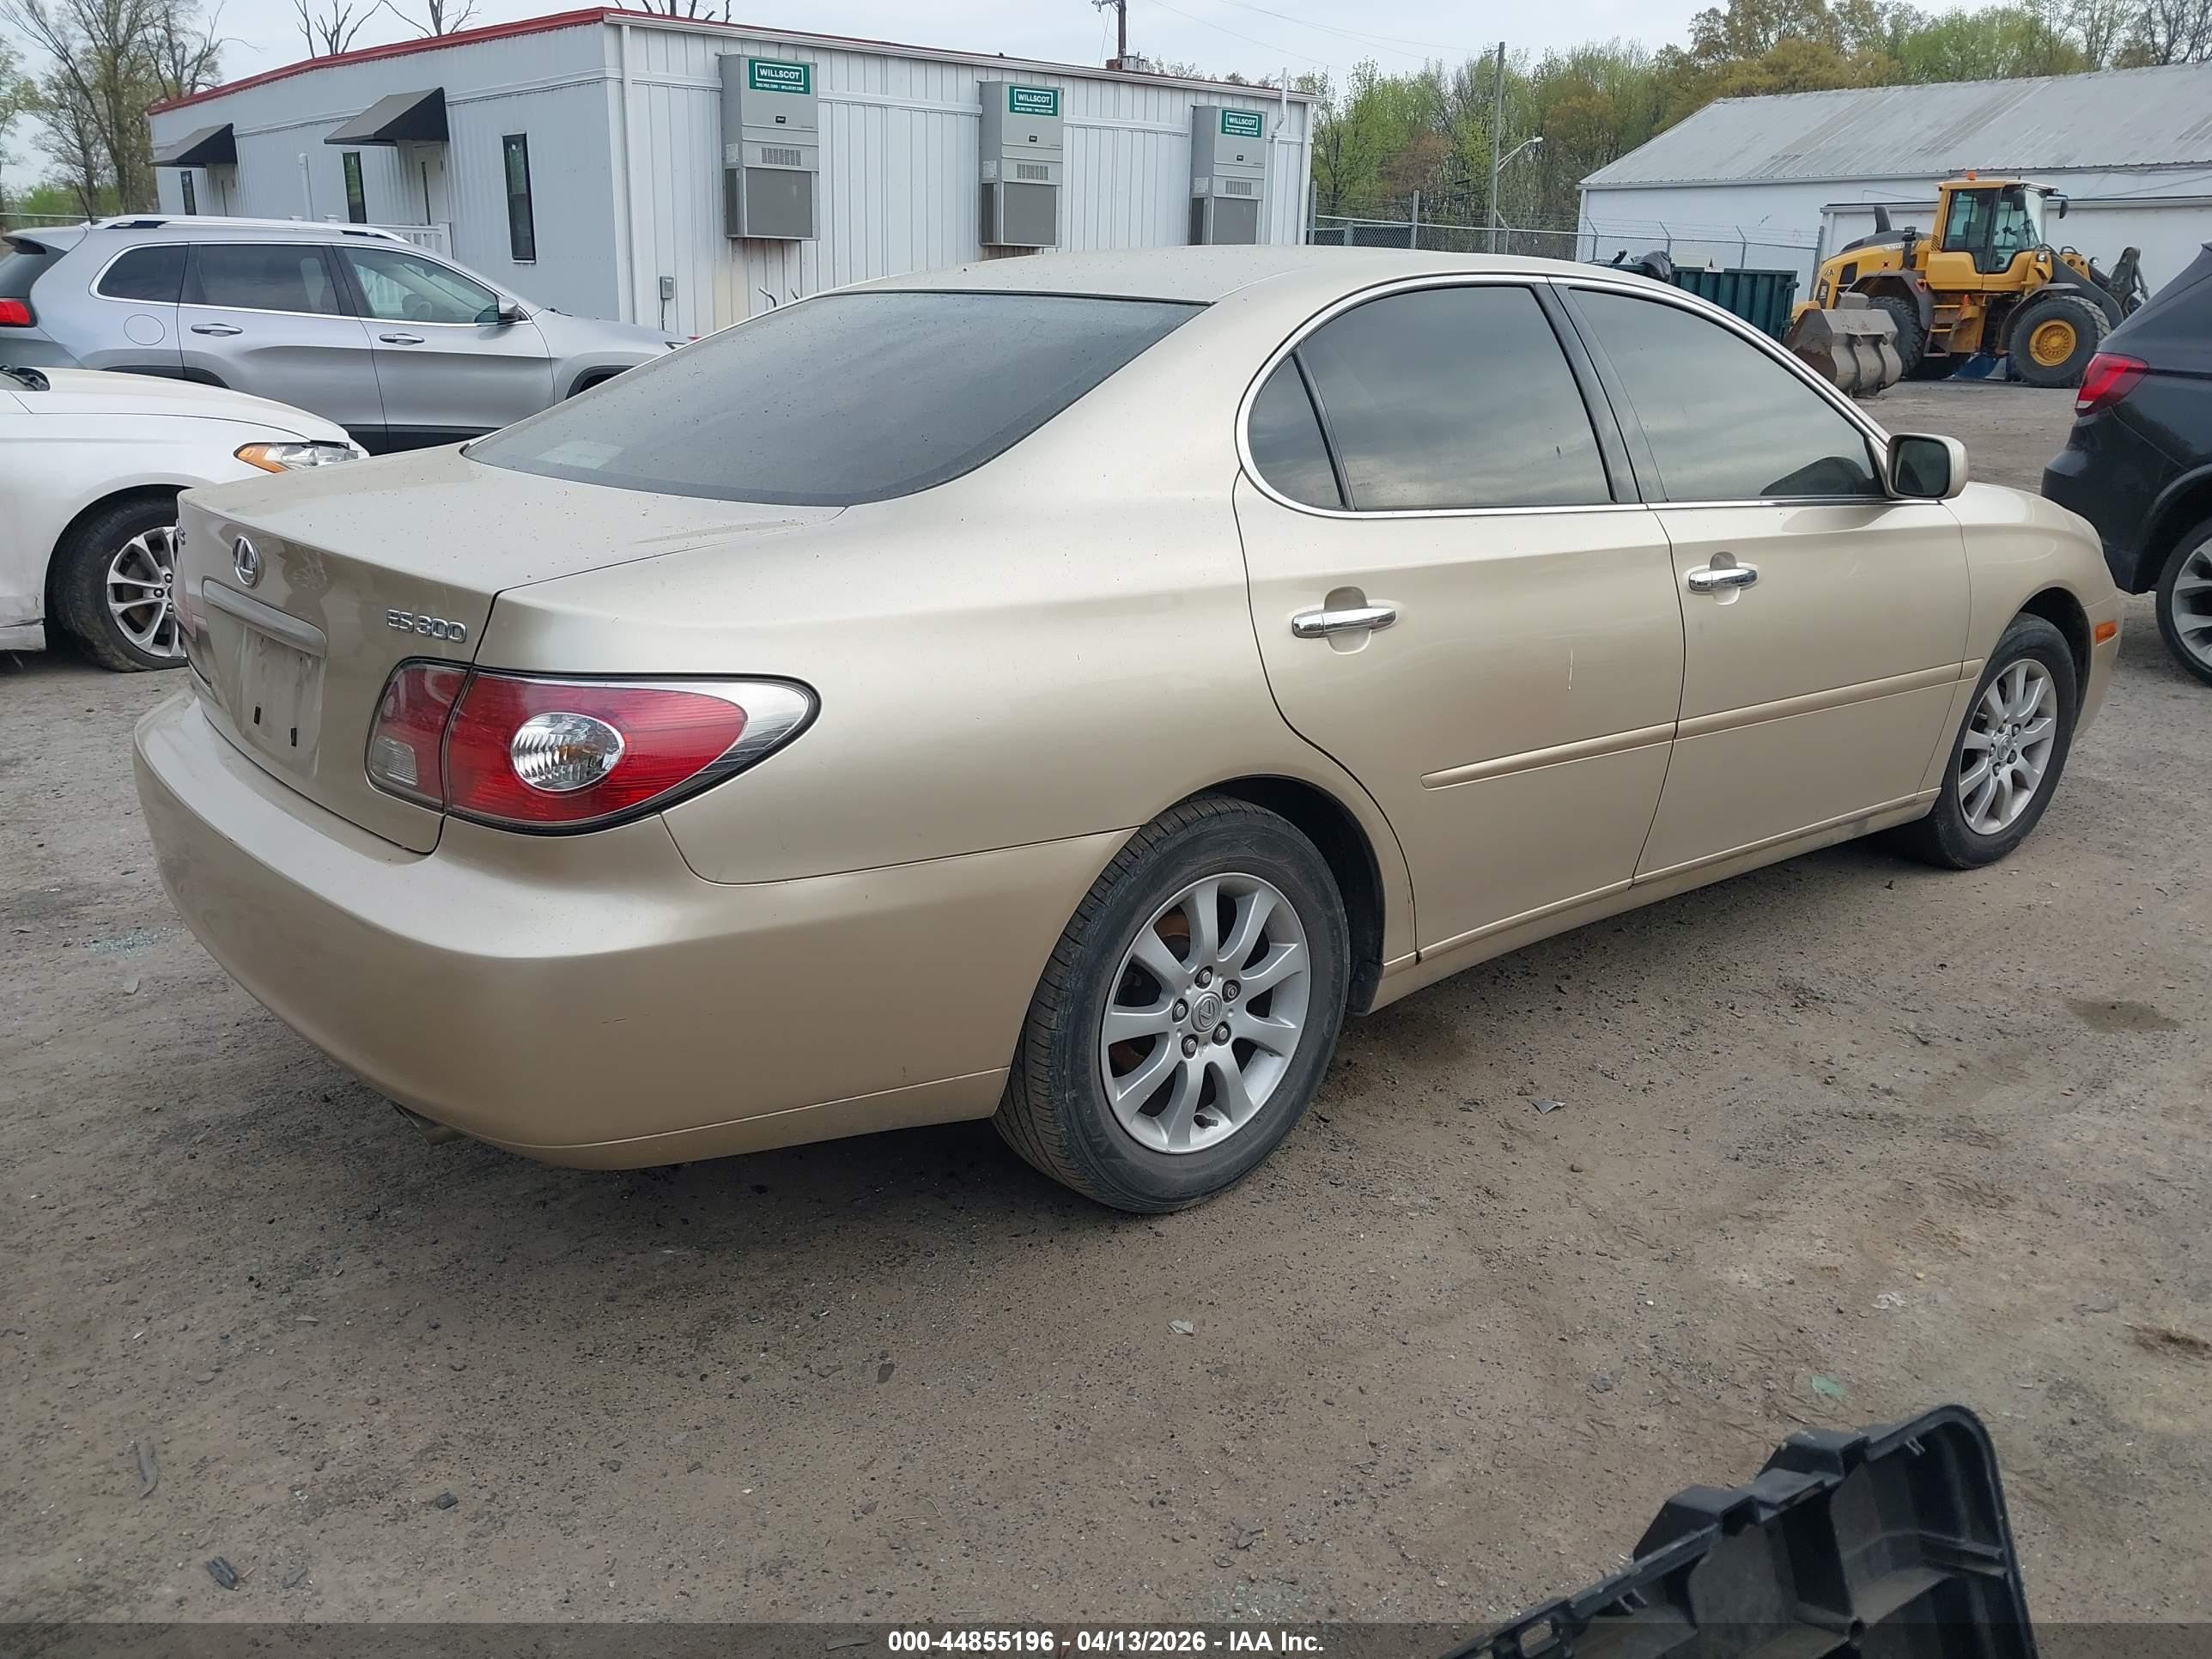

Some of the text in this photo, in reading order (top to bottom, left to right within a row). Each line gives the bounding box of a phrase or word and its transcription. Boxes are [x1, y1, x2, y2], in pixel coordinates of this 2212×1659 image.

[759, 68, 800, 79] WILLSCOT
[1018, 94, 1050, 104] WILLSCOT
[1228, 116, 1255, 126] WILLSCOT
[387, 608, 467, 643] ES 300
